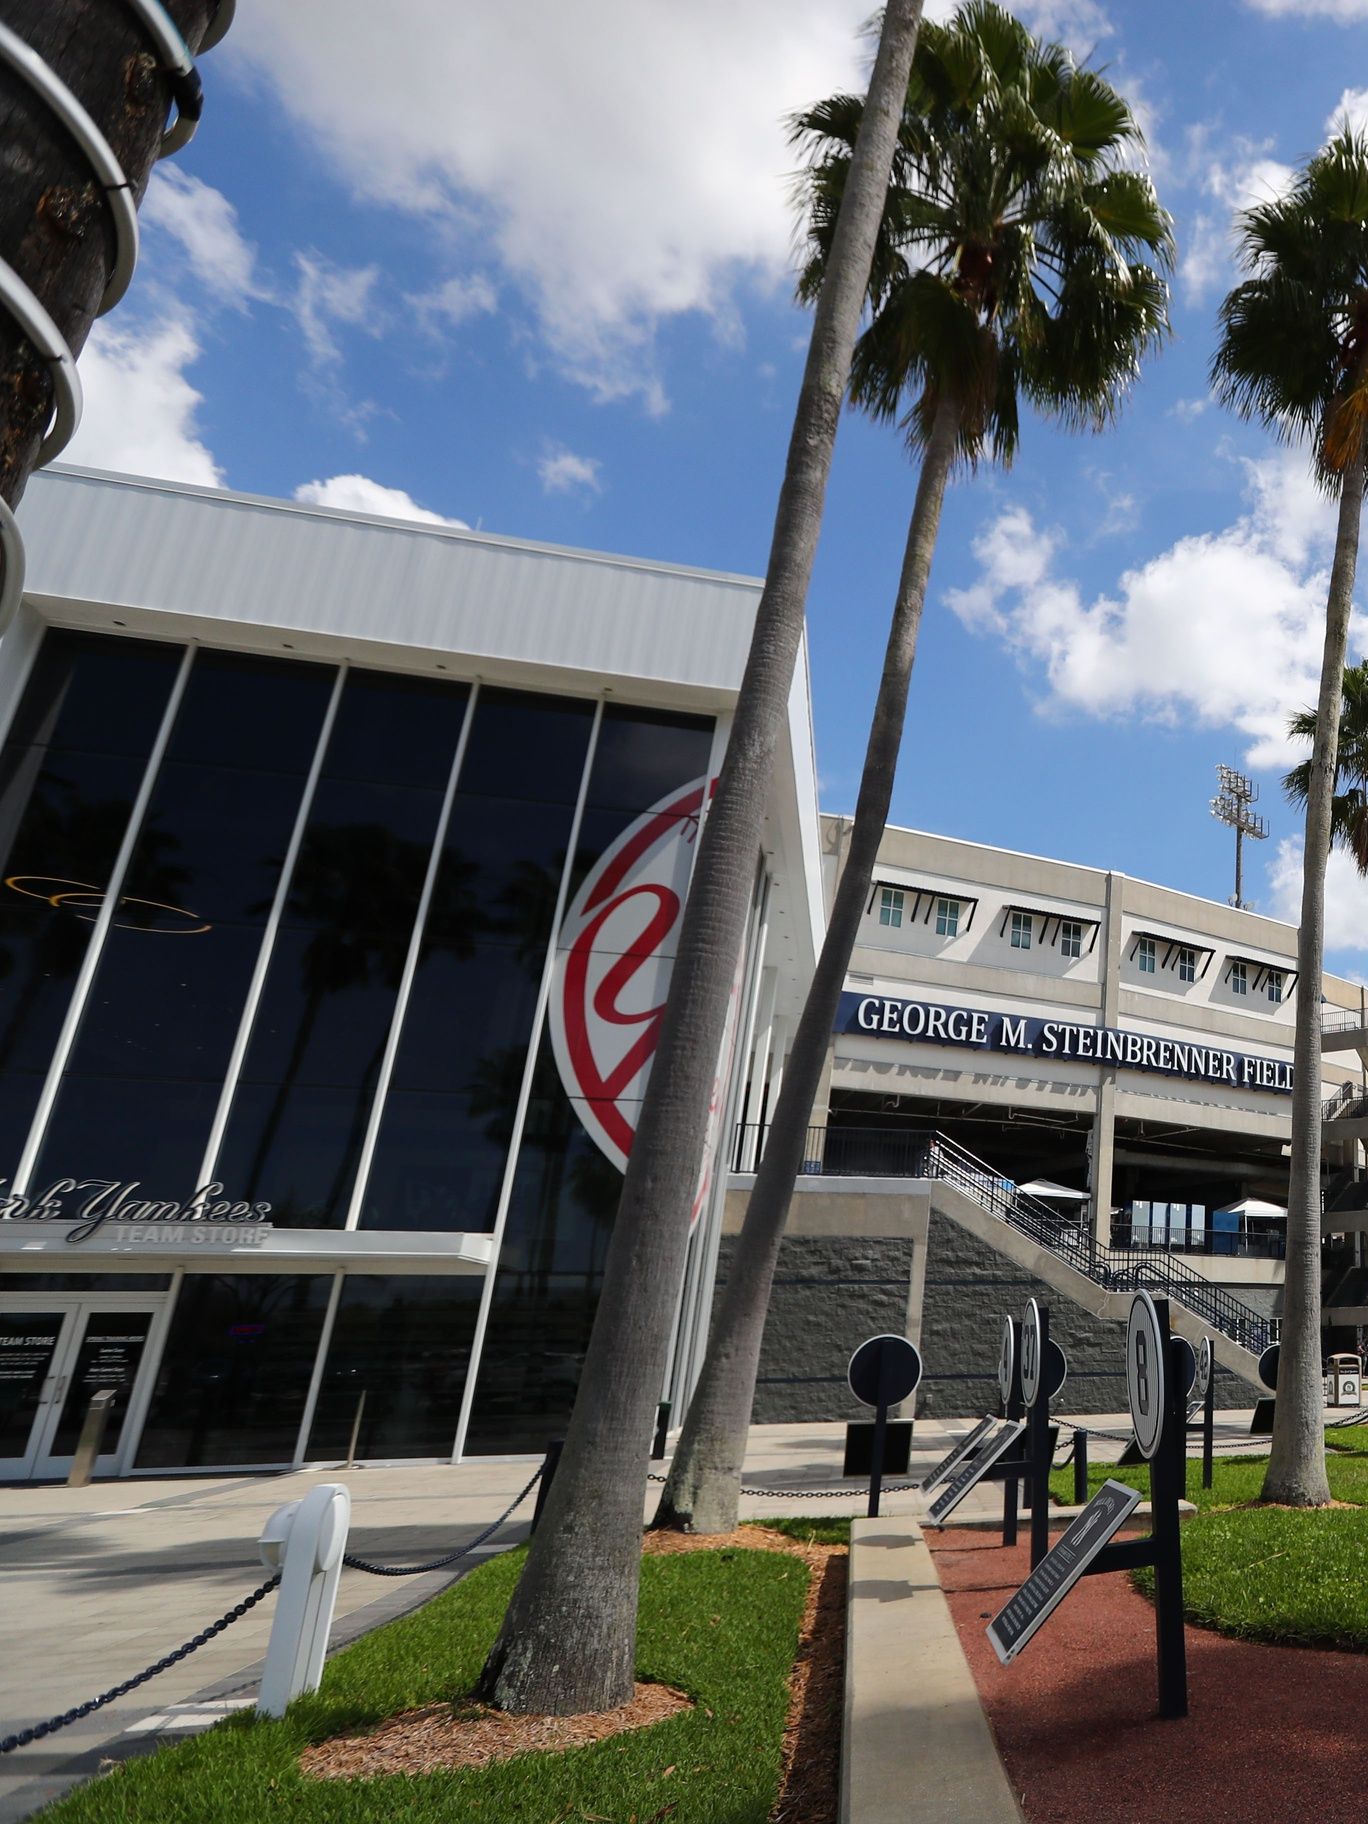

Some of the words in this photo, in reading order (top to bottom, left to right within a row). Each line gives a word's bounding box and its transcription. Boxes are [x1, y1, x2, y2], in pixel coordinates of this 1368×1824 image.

[858, 998, 989, 1043] GEORGE
[1000, 1016, 1033, 1049] M.
[1042, 1023, 1237, 1081] STEINBRENNER
[65, 1178, 272, 1243] Yankees
[115, 1226, 183, 1244] TEAM
[190, 1226, 270, 1247] STORE
[1023, 1325, 1036, 1380] 37
[1136, 1329, 1150, 1417] 8
